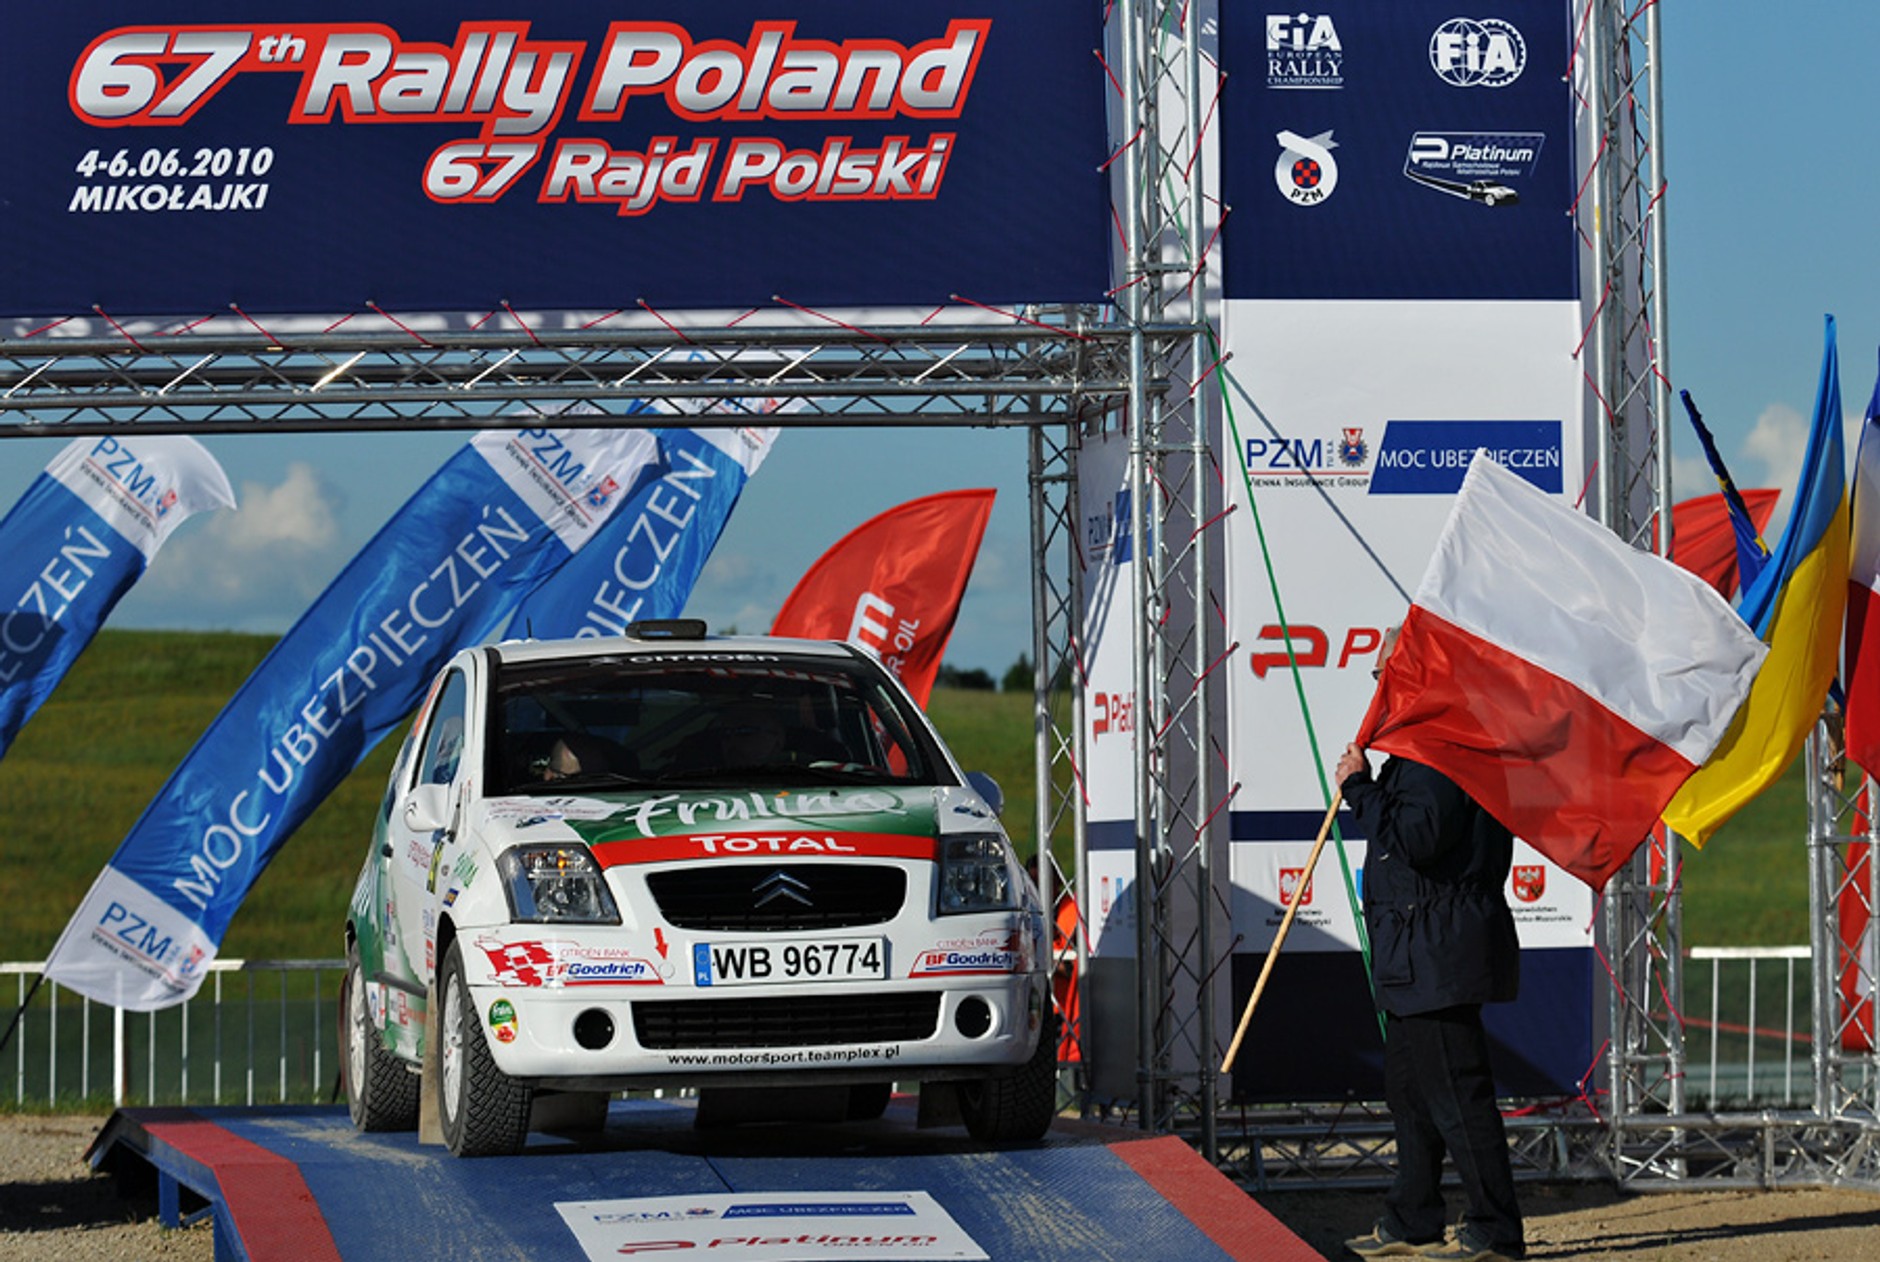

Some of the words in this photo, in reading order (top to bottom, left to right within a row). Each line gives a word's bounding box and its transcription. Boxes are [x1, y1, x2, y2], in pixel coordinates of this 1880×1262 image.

[1267, 60, 1343, 77] RALLY
[1267, 76, 1344, 85] CHAMPIONSHIP
[302, 31, 574, 136] Rally
[591, 29, 979, 111] Poland
[76, 147, 274, 178] 4-6.06.2010
[1450, 144, 1534, 162] Platinum
[425, 143, 539, 199] 67
[546, 140, 711, 210] Rajd
[721, 138, 949, 197] Polski
[68, 183, 269, 212] MIKOŁAJKI
[1290, 187, 1324, 203] PZM
[1246, 438, 1322, 468] PZM
[1380, 449, 1427, 468] MOC
[1431, 445, 1560, 468] UBEIECZEŃ
[90, 435, 156, 499] PZM
[893, 617, 920, 653] OIL
[173, 790, 271, 911] MOC
[257, 504, 531, 795] UBEZPIECZEŃ
[689, 835, 857, 853] TOTAL
[100, 901, 173, 960] PZM
[546, 962, 646, 977] BFGoodrich
[713, 948, 772, 980] WB
[783, 942, 881, 978] 96774
[925, 952, 1012, 966] BFGoodrich
[698, 972, 710, 981] PL
[708, 1235, 937, 1247] Platinum
